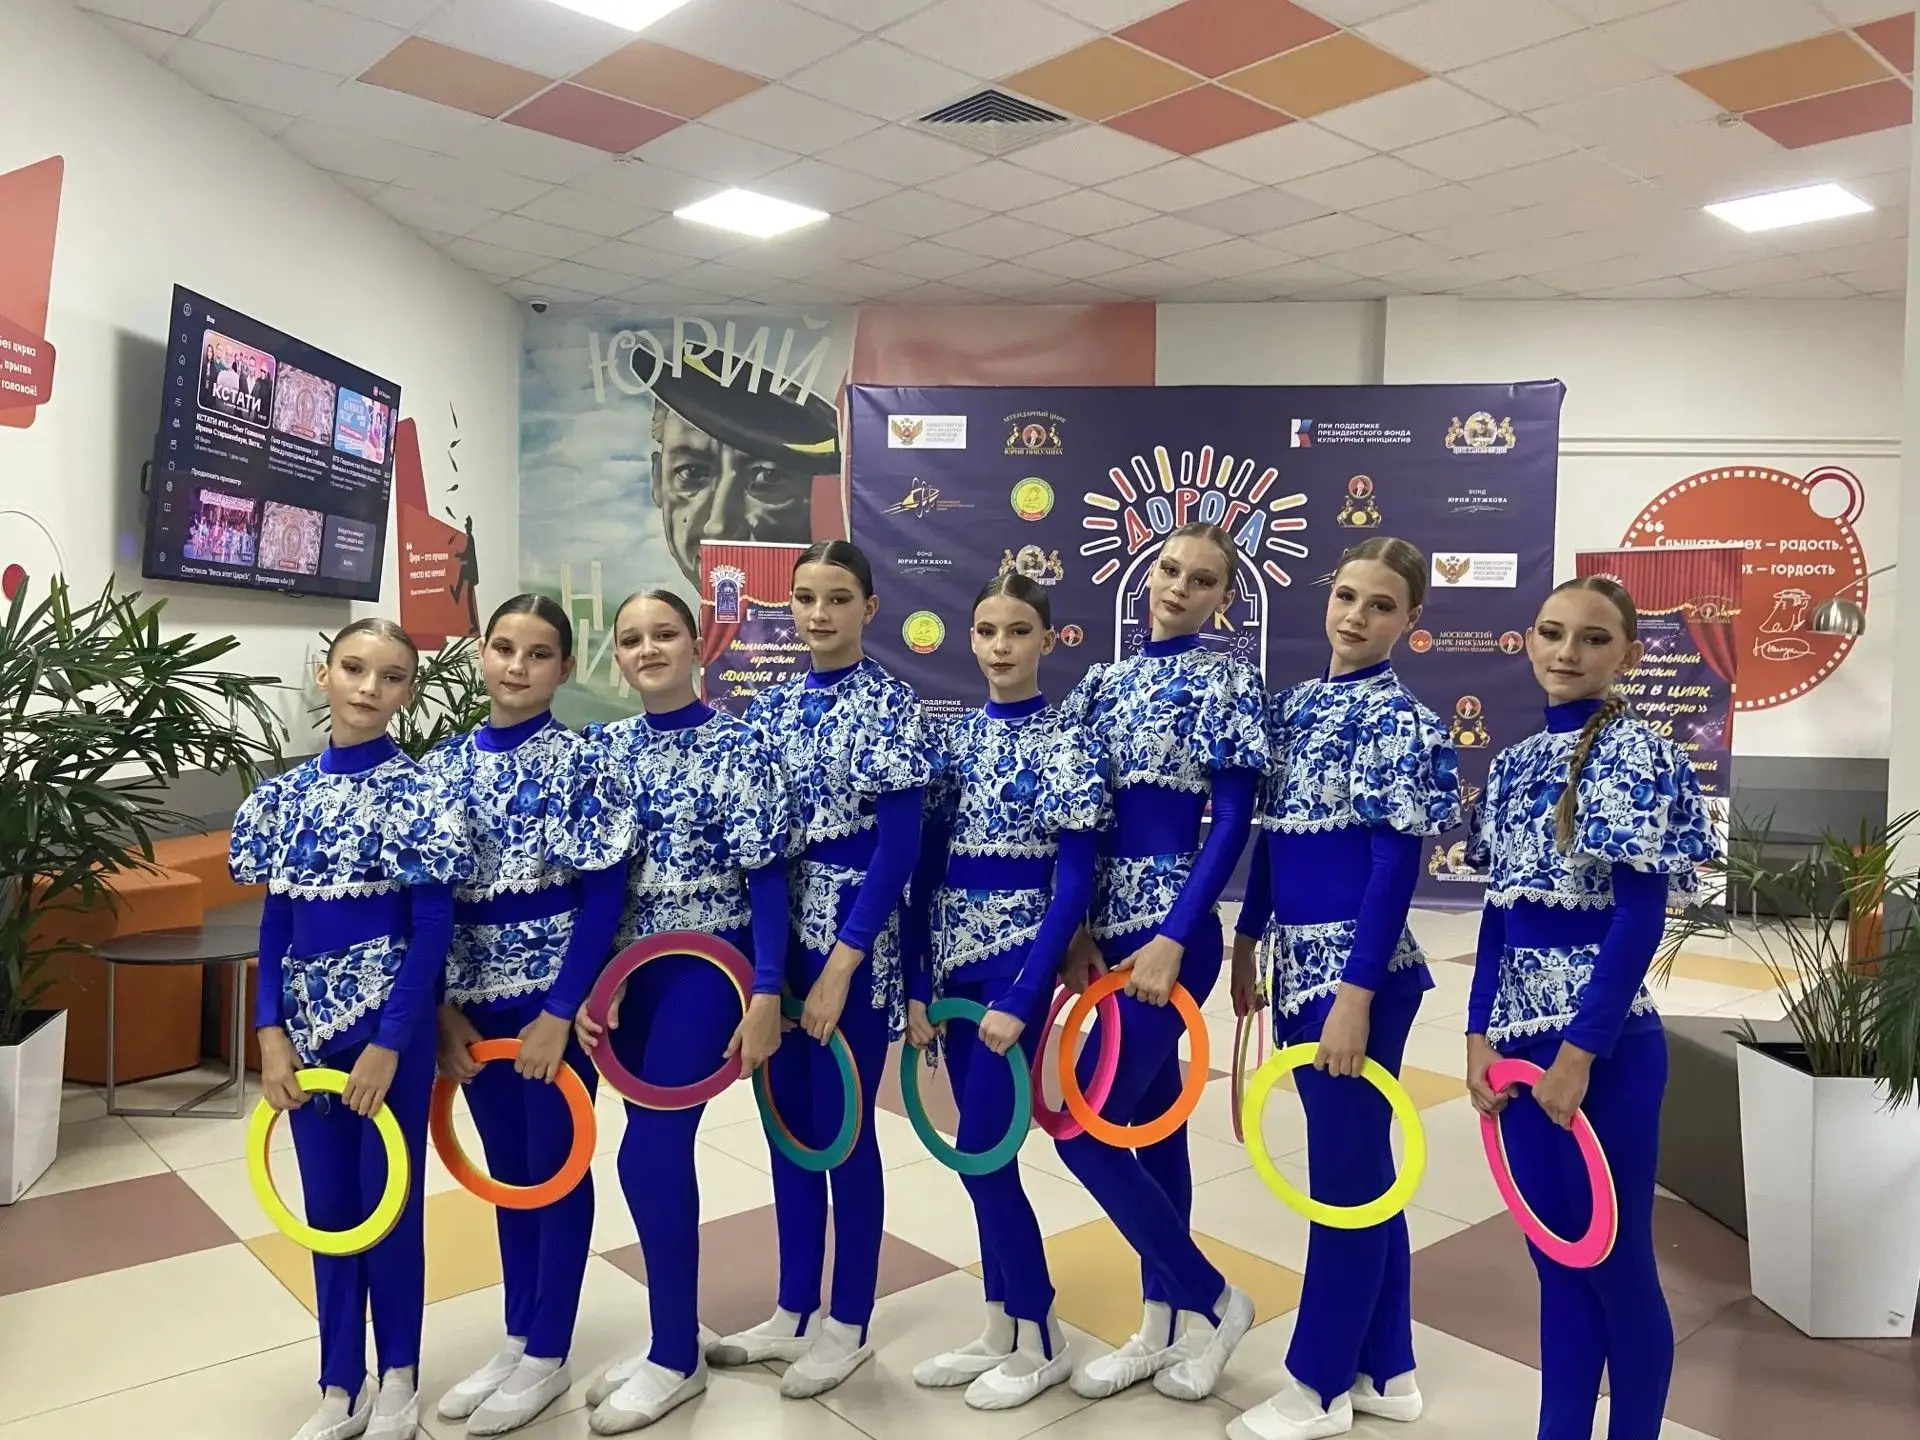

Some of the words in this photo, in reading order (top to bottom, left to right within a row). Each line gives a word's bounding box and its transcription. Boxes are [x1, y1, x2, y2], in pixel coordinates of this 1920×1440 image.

[588, 315, 832, 407] ЮРИЙ
[212, 382, 262, 412] КСТАТИ
[1124, 488, 1267, 557] ДОРОГА
[1779, 538, 1844, 556] радость.
[1770, 564, 1836, 579] гордость
[1439, 630, 1492, 638] МОСКОВСКИЙ
[730, 639, 811, 652] Национальны
[1432, 639, 1454, 647] ЦИРК
[1454, 639, 1498, 647] НИКУЛИНА
[749, 655, 796, 669] проект
[718, 669, 773, 682] «ДОРОГА
[776, 671, 787, 682] В
[1650, 684, 1662, 696] В
